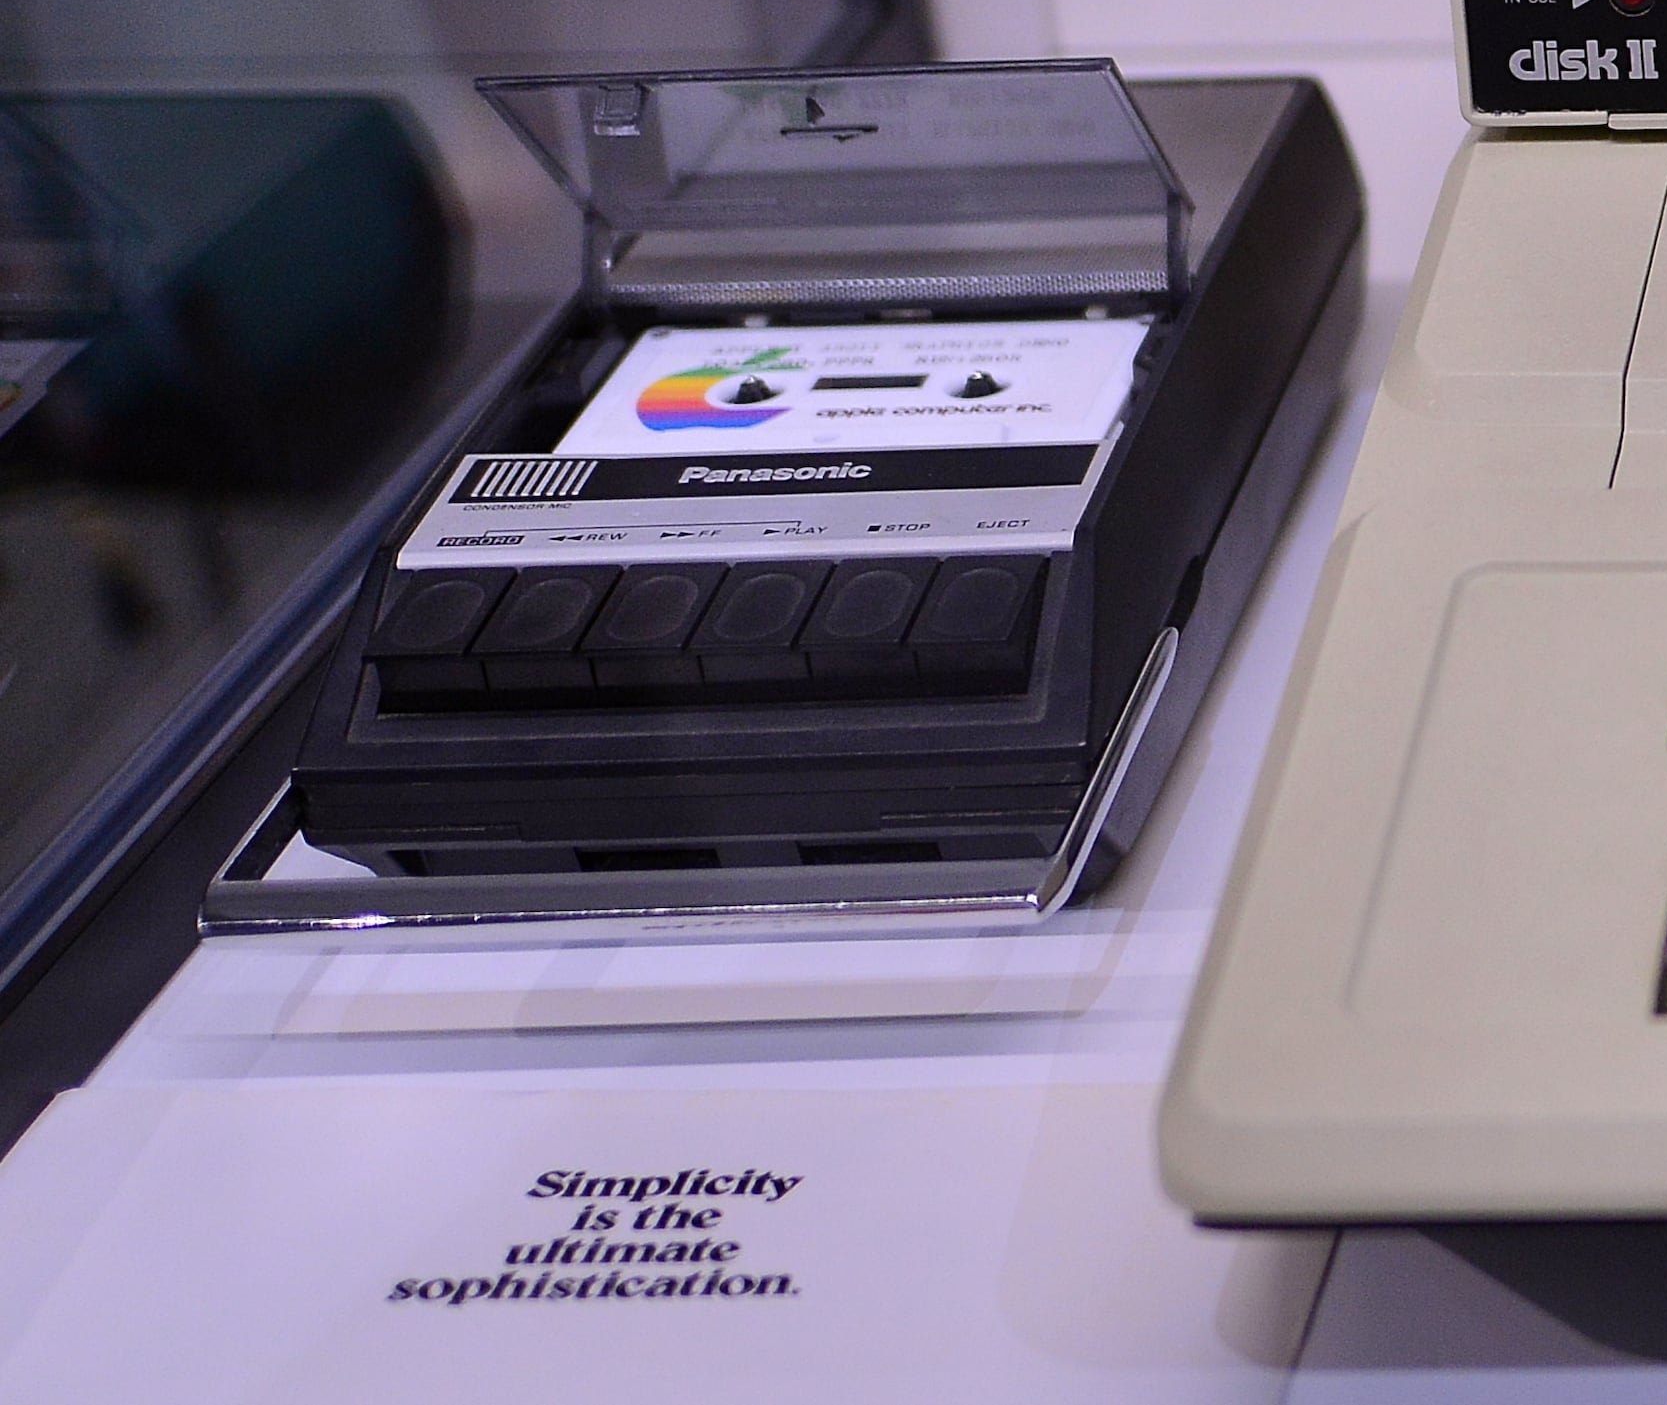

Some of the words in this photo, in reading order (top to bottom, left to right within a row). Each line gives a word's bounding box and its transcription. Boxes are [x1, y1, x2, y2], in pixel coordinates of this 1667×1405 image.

[1508, 39, 1619, 81] disk
[677, 461, 873, 485] Panasonic
[784, 525, 829, 536] PLAY
[884, 522, 932, 533] STOP
[976, 519, 1031, 530] EJECT
[440, 535, 524, 546] RECORD
[585, 532, 629, 542] REW
[698, 529, 722, 538] FF
[527, 1168, 805, 1202] Simplicity
[570, 1203, 621, 1231] is
[633, 1201, 724, 1231] the
[504, 1236, 743, 1266] ultimate
[387, 1268, 803, 1307] sophistication.
